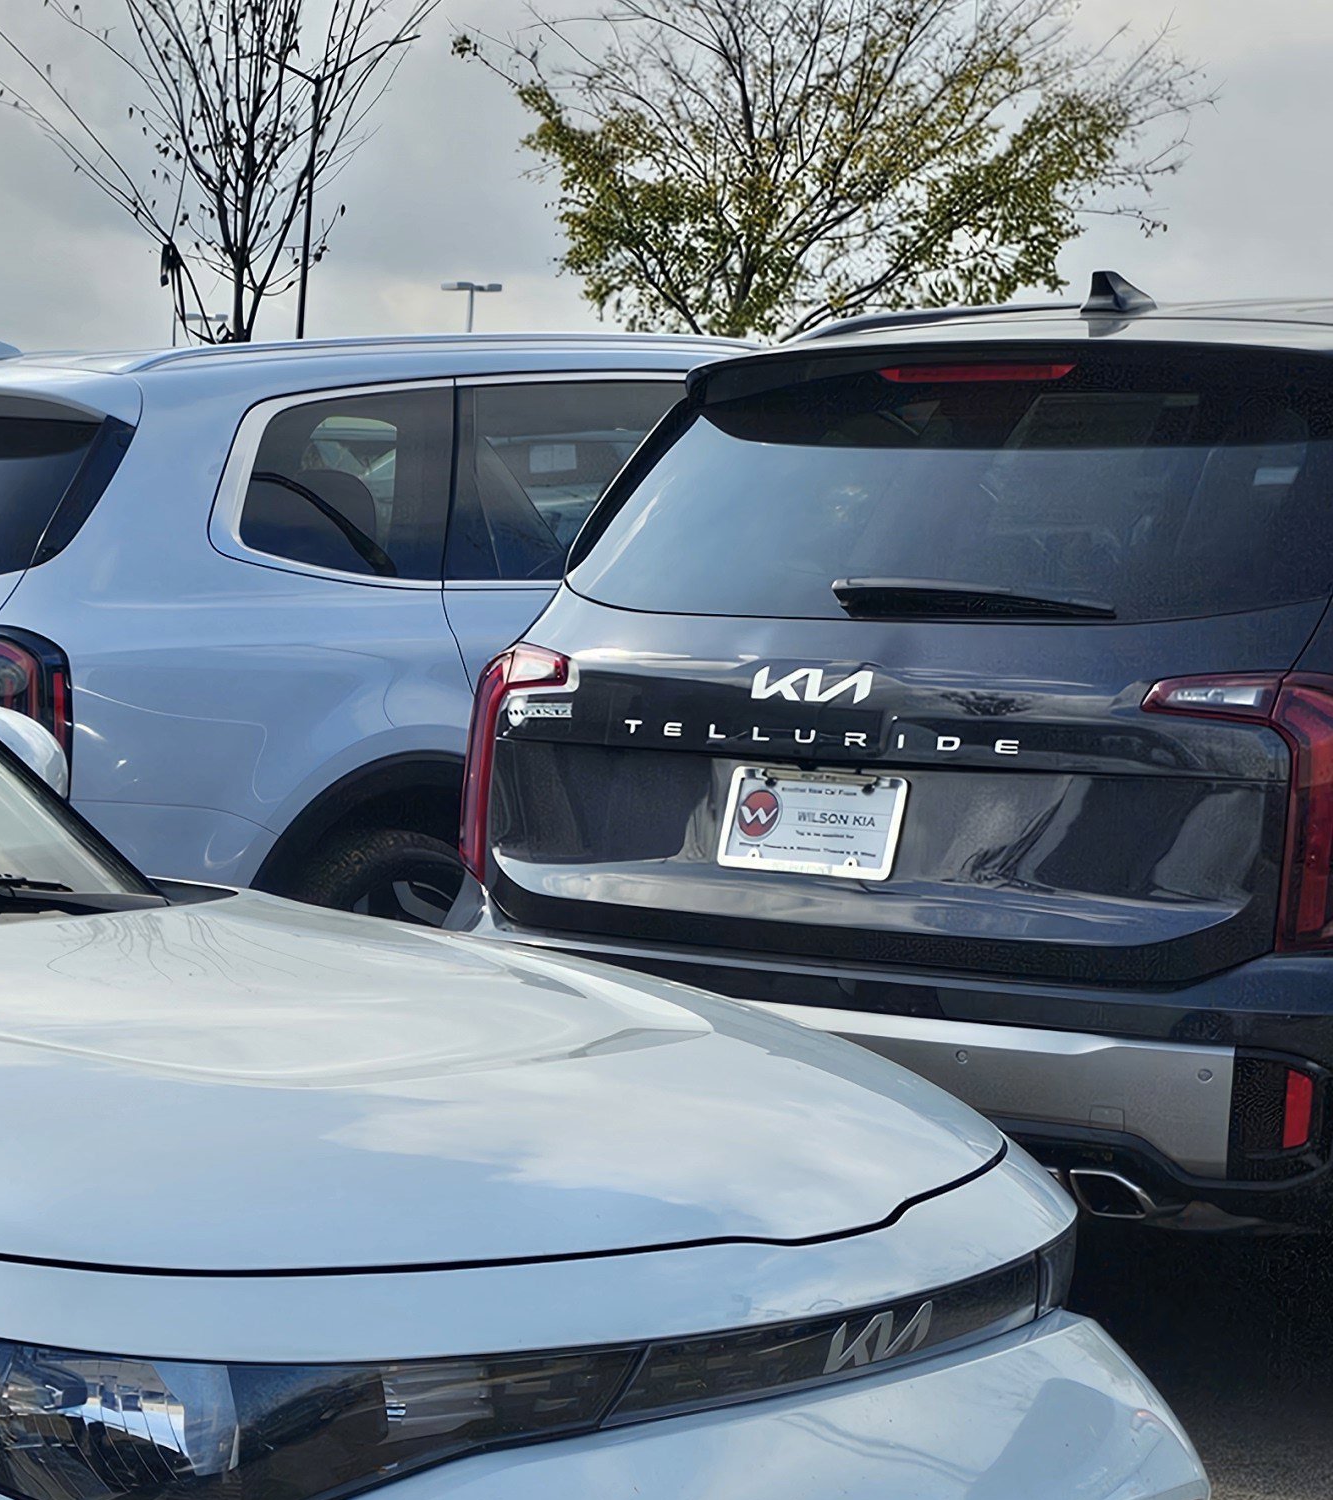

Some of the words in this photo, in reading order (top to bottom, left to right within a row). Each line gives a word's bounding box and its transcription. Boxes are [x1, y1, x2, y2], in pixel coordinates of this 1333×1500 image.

[750, 665, 874, 704] KIA
[624, 719, 1021, 755] TELLURIDE
[797, 810, 849, 826] WILSON
[852, 814, 876, 828] KIA
[822, 1300, 933, 1375] KIA
